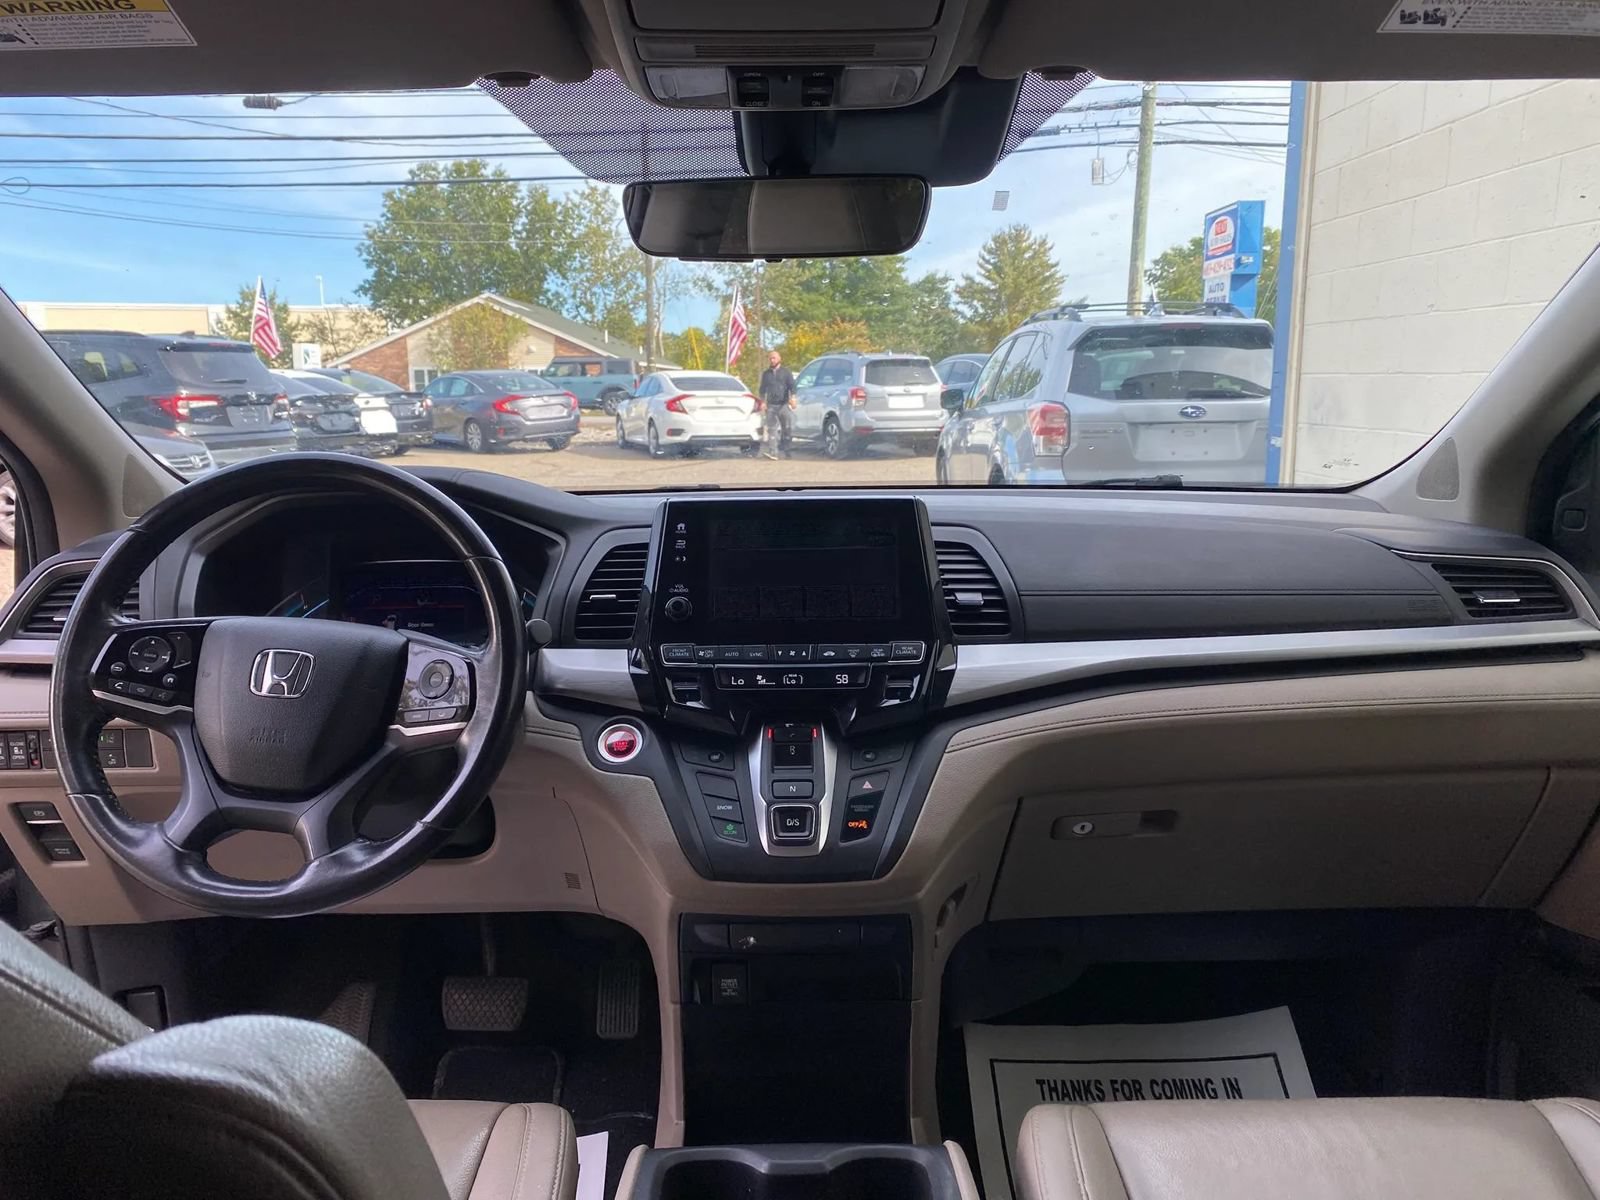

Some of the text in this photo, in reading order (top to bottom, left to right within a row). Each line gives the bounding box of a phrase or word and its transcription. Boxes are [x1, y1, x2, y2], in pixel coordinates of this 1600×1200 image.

[0, 0, 137, 14] WARNING
[31, 14, 96, 22] ADVANCED
[1208, 282, 1225, 294] AUTO
[731, 676, 745, 685] Lo
[786, 677, 796, 685] Lo
[786, 818, 800, 826] D/S
[1035, 1077, 1243, 1101] THANKS FOR COMING IN
